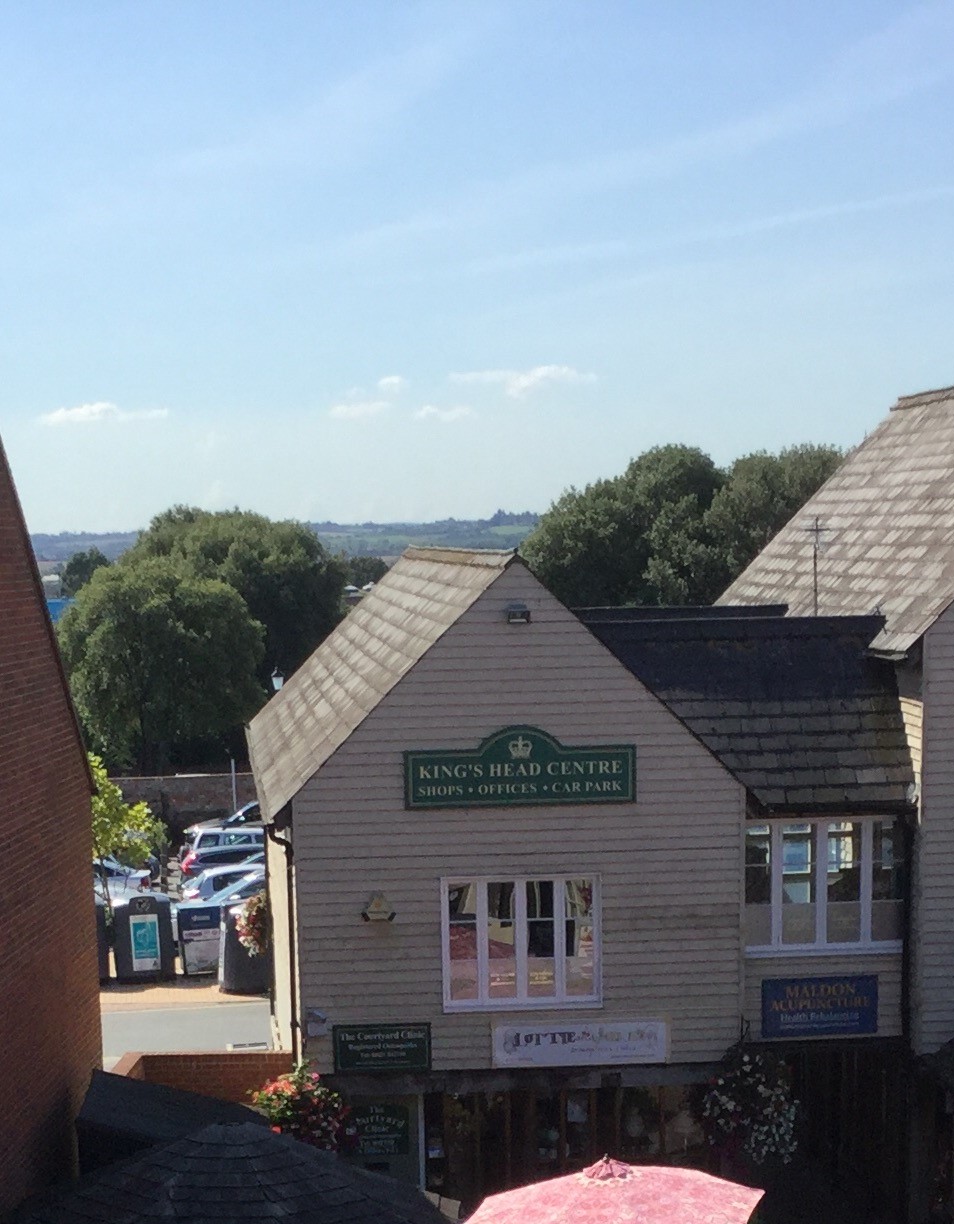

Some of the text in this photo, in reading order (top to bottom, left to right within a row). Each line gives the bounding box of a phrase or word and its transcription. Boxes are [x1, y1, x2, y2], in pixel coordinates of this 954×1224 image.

[419, 760, 623, 780] KING'S HEAD CENTRE
[418, 779, 622, 797] SHOPS OFFICES CAR PARK
[786, 984, 856, 998] MALDON
[771, 997, 870, 1011] ACUPUNCTURE
[341, 1033, 356, 1042] The
[357, 1031, 399, 1042] Courtyard
